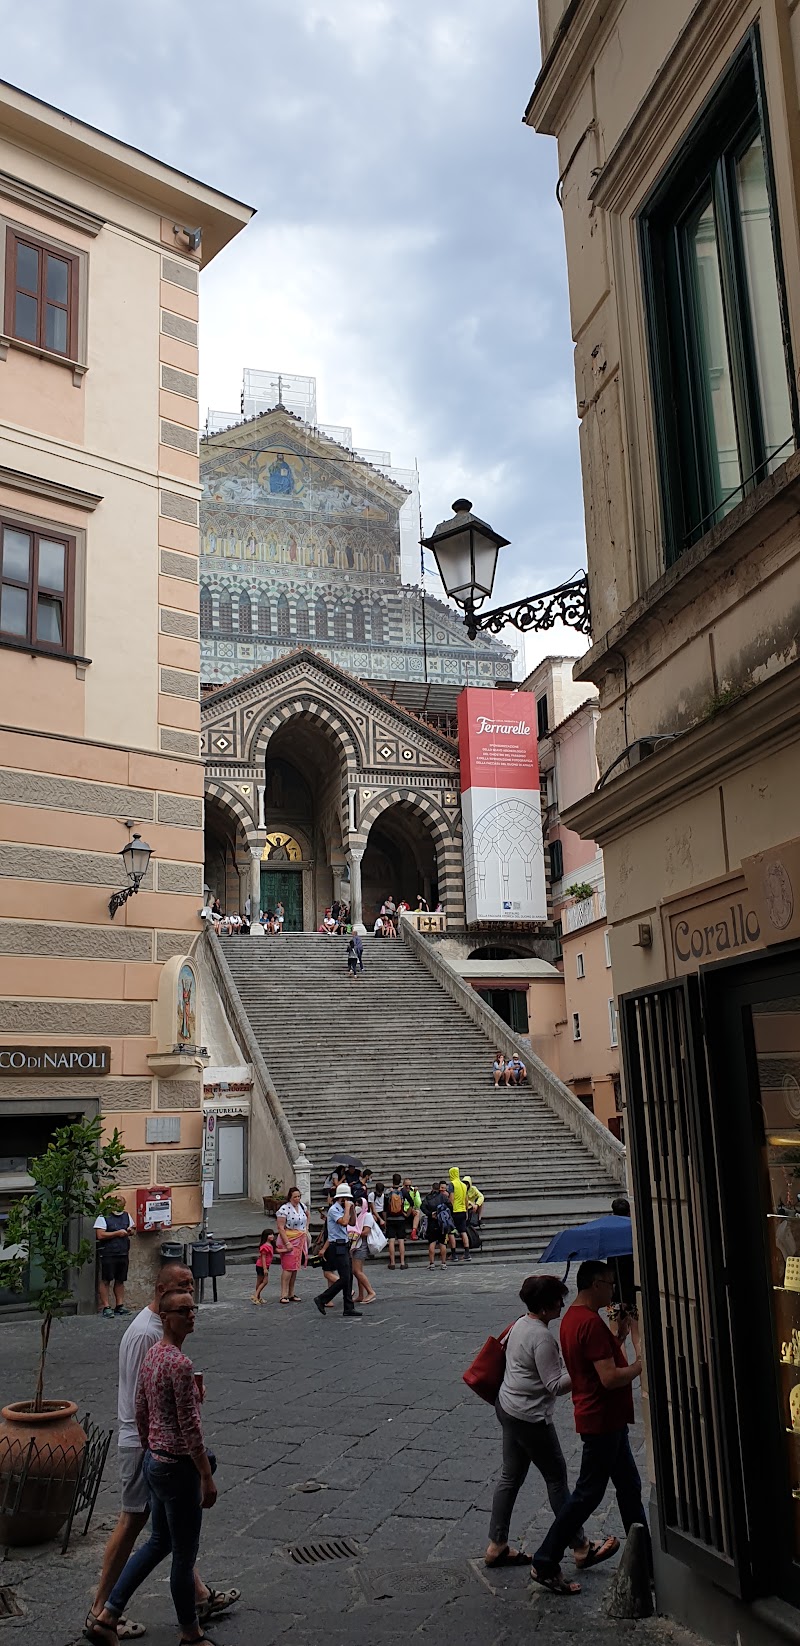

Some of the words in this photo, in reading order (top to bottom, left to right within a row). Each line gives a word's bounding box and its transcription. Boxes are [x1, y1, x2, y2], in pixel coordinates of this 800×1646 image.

[476, 716, 530, 735] Ferrarelle
[675, 903, 760, 961] Corallo
[27, 1056, 40, 1068] DI
[43, 1052, 105, 1068] NAPOLI
